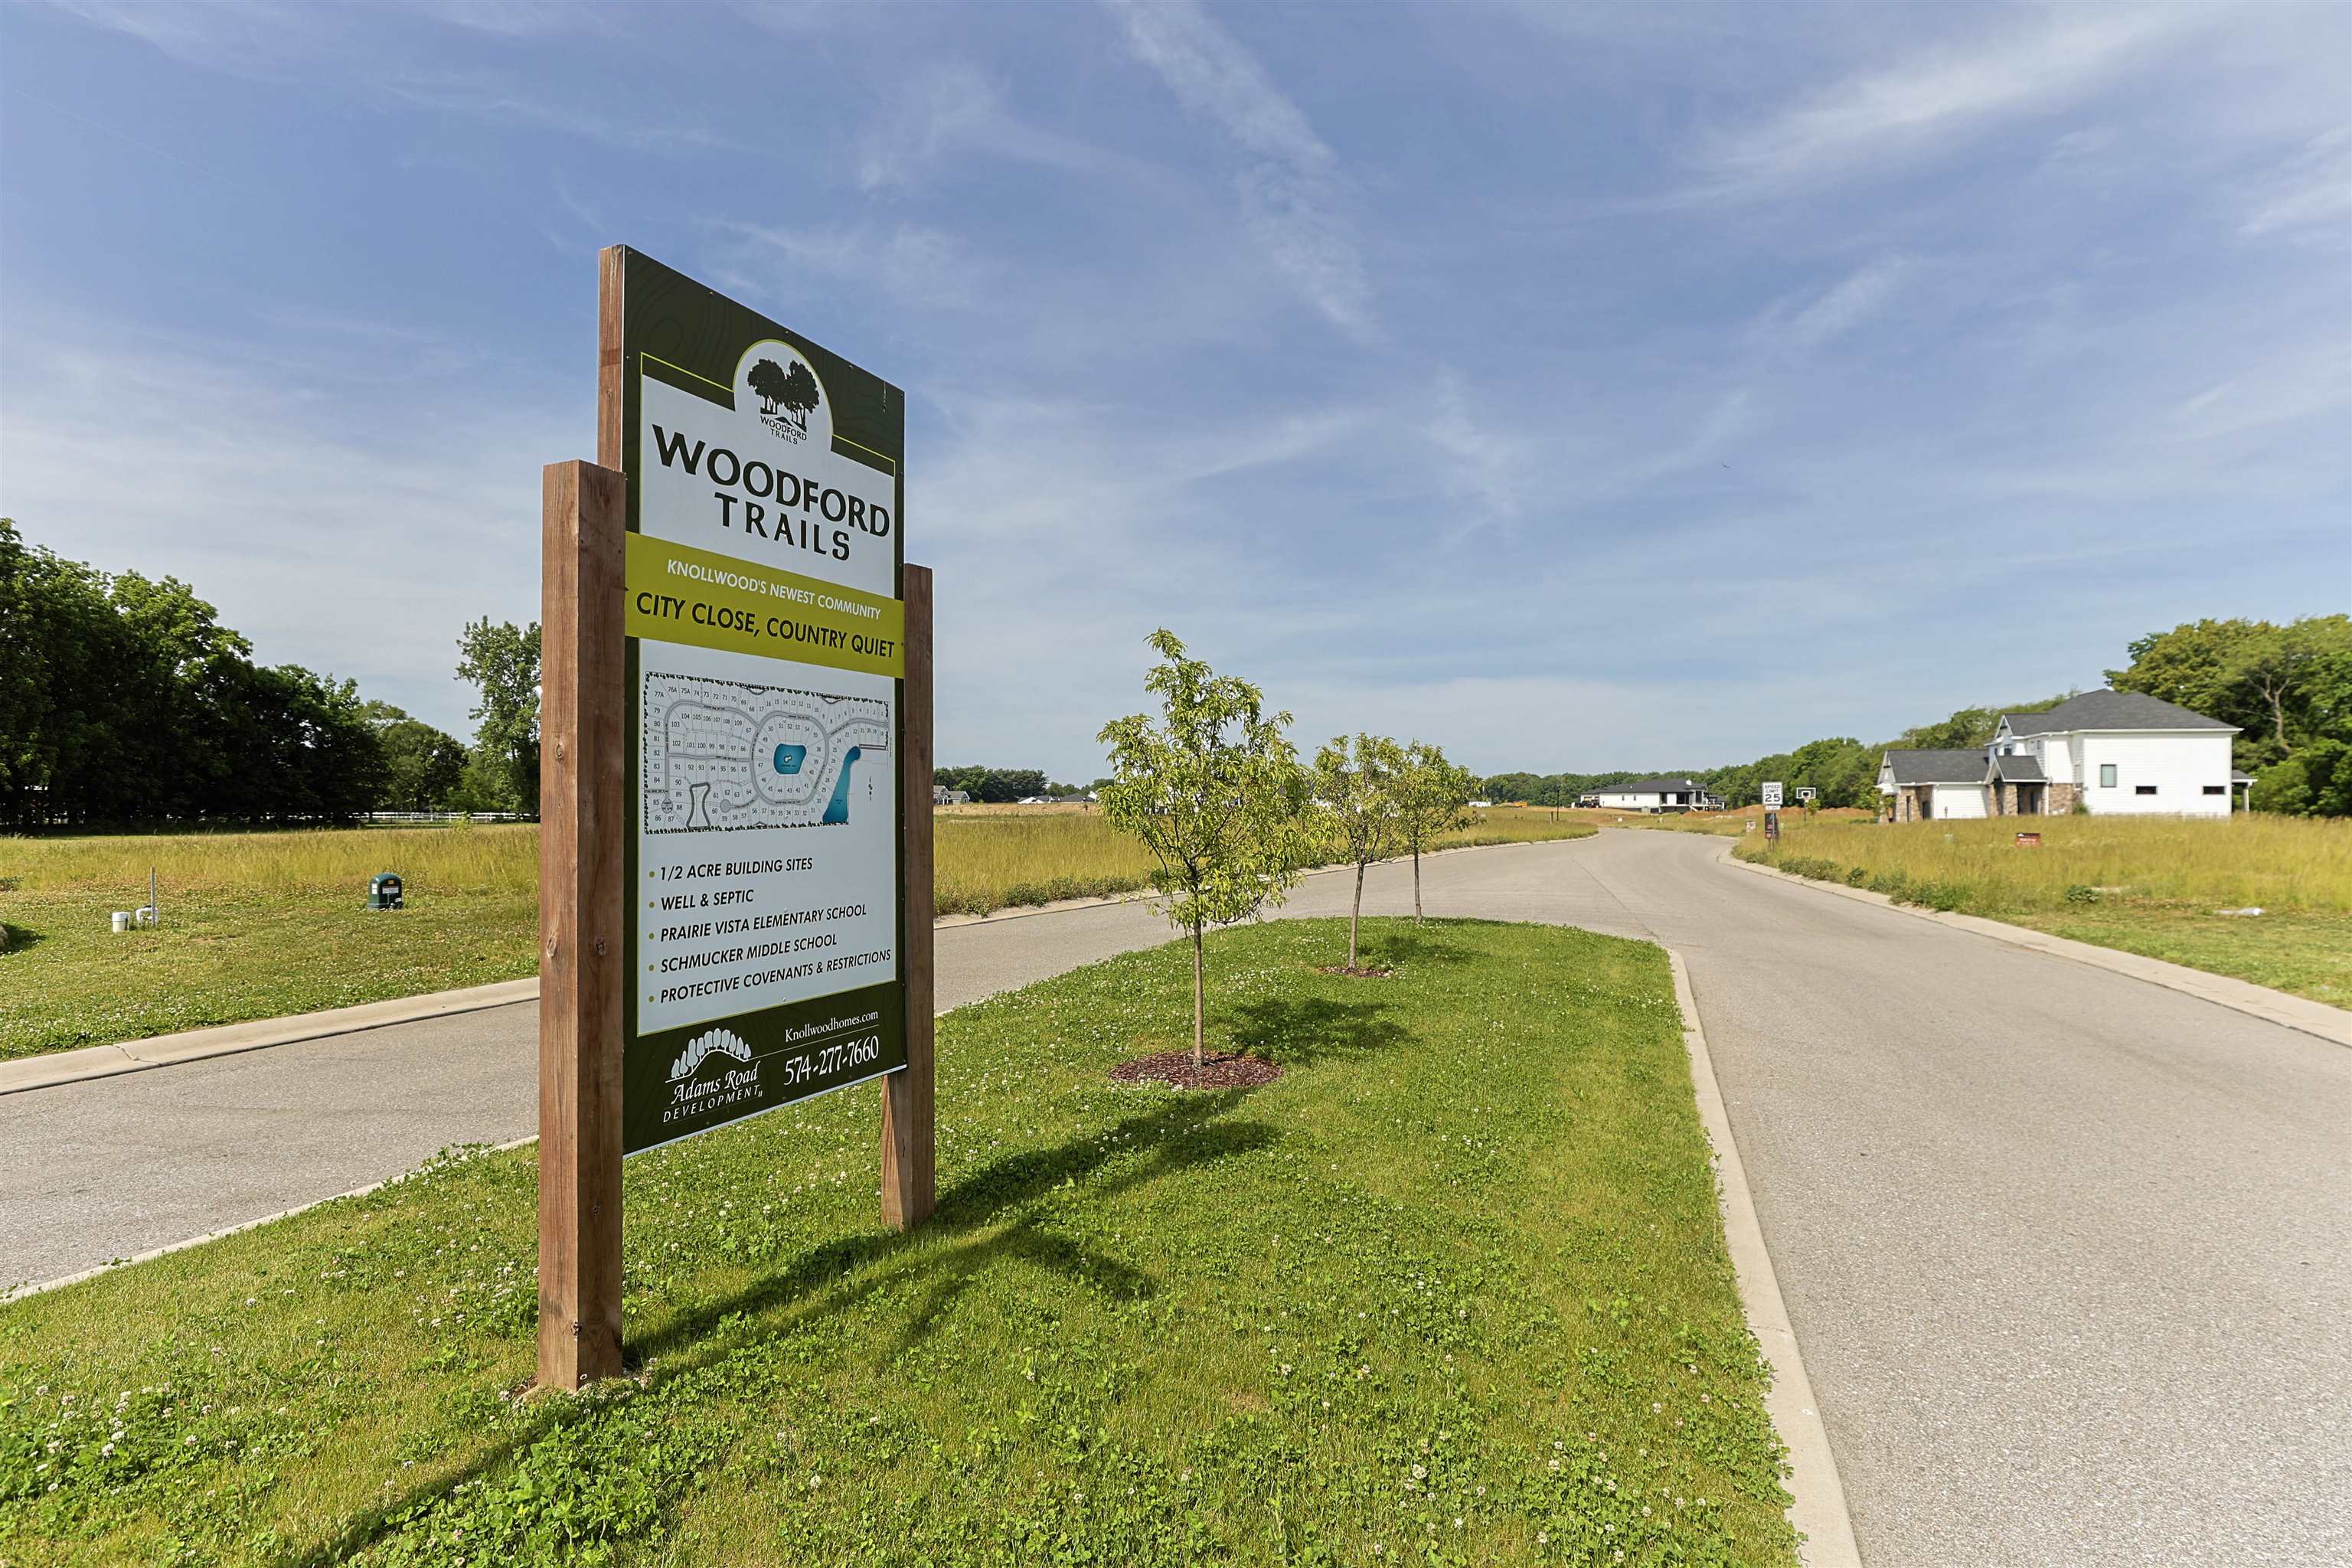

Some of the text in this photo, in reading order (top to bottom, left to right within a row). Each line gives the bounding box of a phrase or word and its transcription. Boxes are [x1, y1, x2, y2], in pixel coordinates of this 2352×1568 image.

[760, 415, 807, 441] WOODFORD
[771, 428, 798, 445] TRAILS
[652, 424, 890, 537] WOODFORD
[714, 492, 850, 561] TRAILS
[667, 559, 881, 620] KNOLLWOOD'S NEWEST COMMUNITY
[636, 592, 895, 658] CITY CLOSE, COUNTRY QUIET
[660, 858, 813, 881] 1/2 ACRE BUILDING SITES
[661, 889, 753, 910] WELL & SEPTIC
[661, 904, 867, 942] PRAIRIE VISTA ELEMENTARY SCHOOL
[661, 933, 837, 973] SCHMUCKER MIDDLE SCHOOL
[661, 949, 891, 1003] PROTECTIVE COVENANTS & RESTRICTIONS
[785, 1010, 878, 1042] Knollwoodhomes.com
[783, 1035, 879, 1086] 574-277-7660
[671, 1060, 761, 1105] Adams Road
[663, 1084, 760, 1122] DEVELOPMENT
